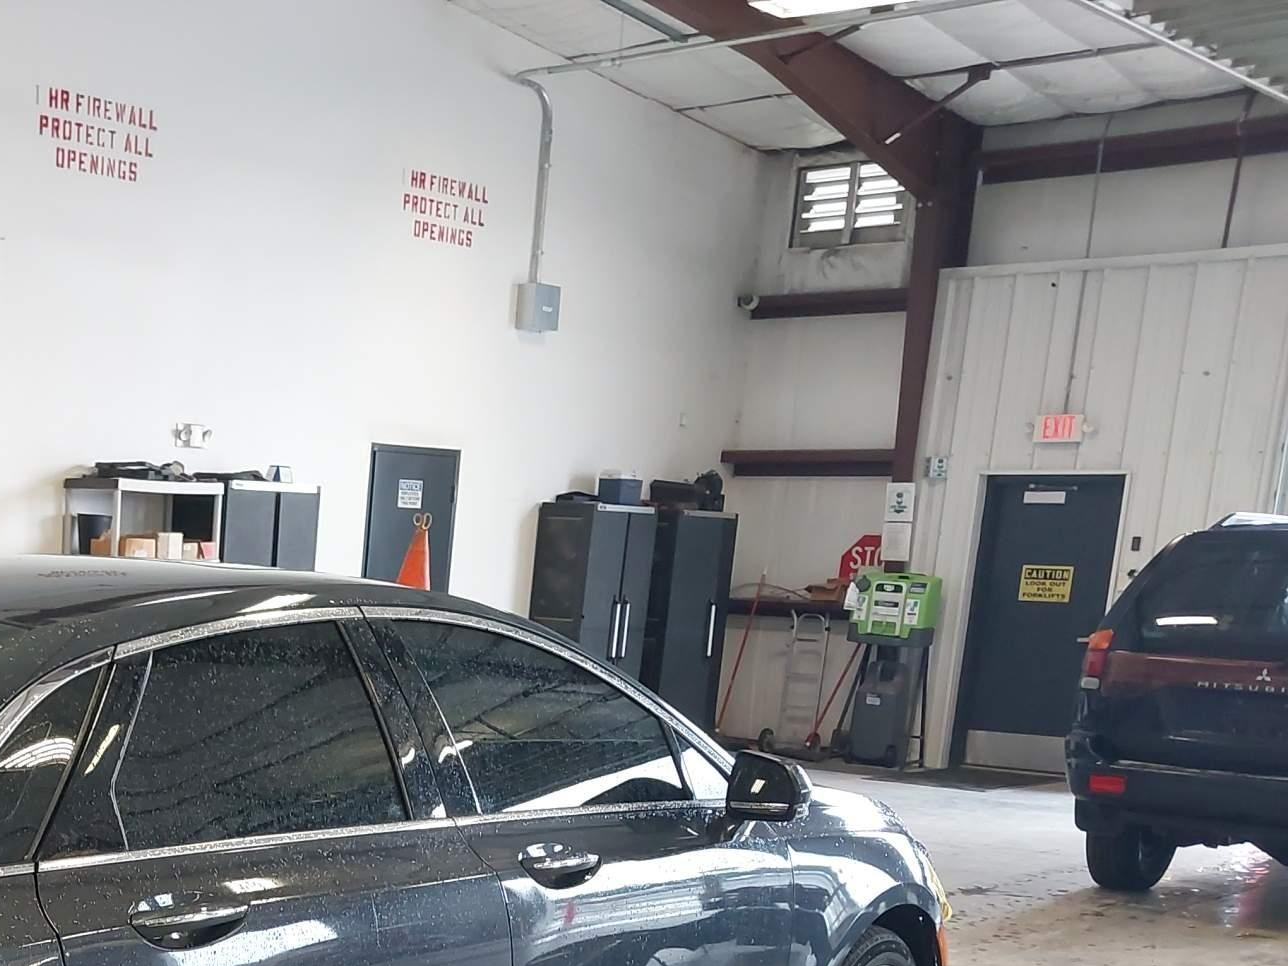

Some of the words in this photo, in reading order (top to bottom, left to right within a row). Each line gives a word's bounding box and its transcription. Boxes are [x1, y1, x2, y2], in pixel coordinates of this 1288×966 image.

[48, 87, 69, 112] HR
[76, 93, 158, 131] FIREWALL
[39, 114, 116, 149] PROTECT
[124, 133, 153, 158] ALL
[55, 146, 138, 182] OPENINGS
[411, 169, 426, 189] HR
[430, 174, 489, 203] FIREWALL
[403, 193, 458, 220] PROTECT
[463, 206, 485, 227] ALL
[414, 220, 472, 247] OPENINGS
[1043, 416, 1075, 439] EXIT
[849, 546, 884, 569] STO
[1025, 570, 1069, 579] CAUTION
